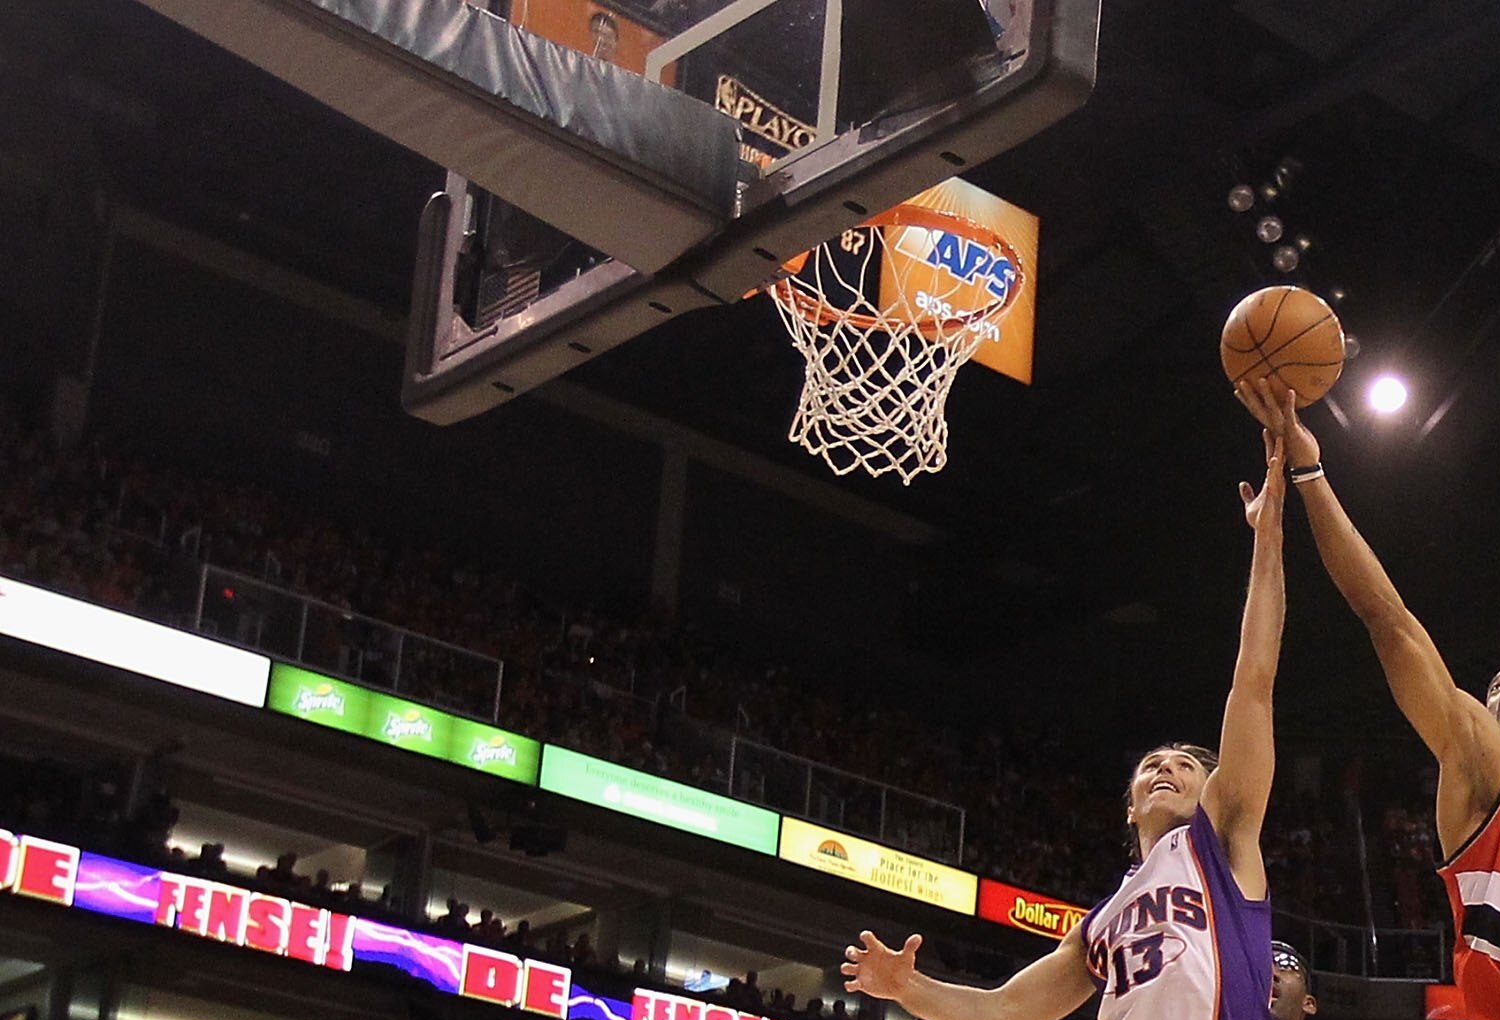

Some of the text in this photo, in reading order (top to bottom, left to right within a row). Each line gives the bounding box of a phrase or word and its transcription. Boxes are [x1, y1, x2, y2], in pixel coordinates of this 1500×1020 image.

[926, 231, 1017, 299] APS
[156, 873, 355, 971] FENSE!
[1014, 896, 1060, 930] Dollar
[459, 943, 572, 1020] DE
[1112, 931, 1165, 1000] 13
